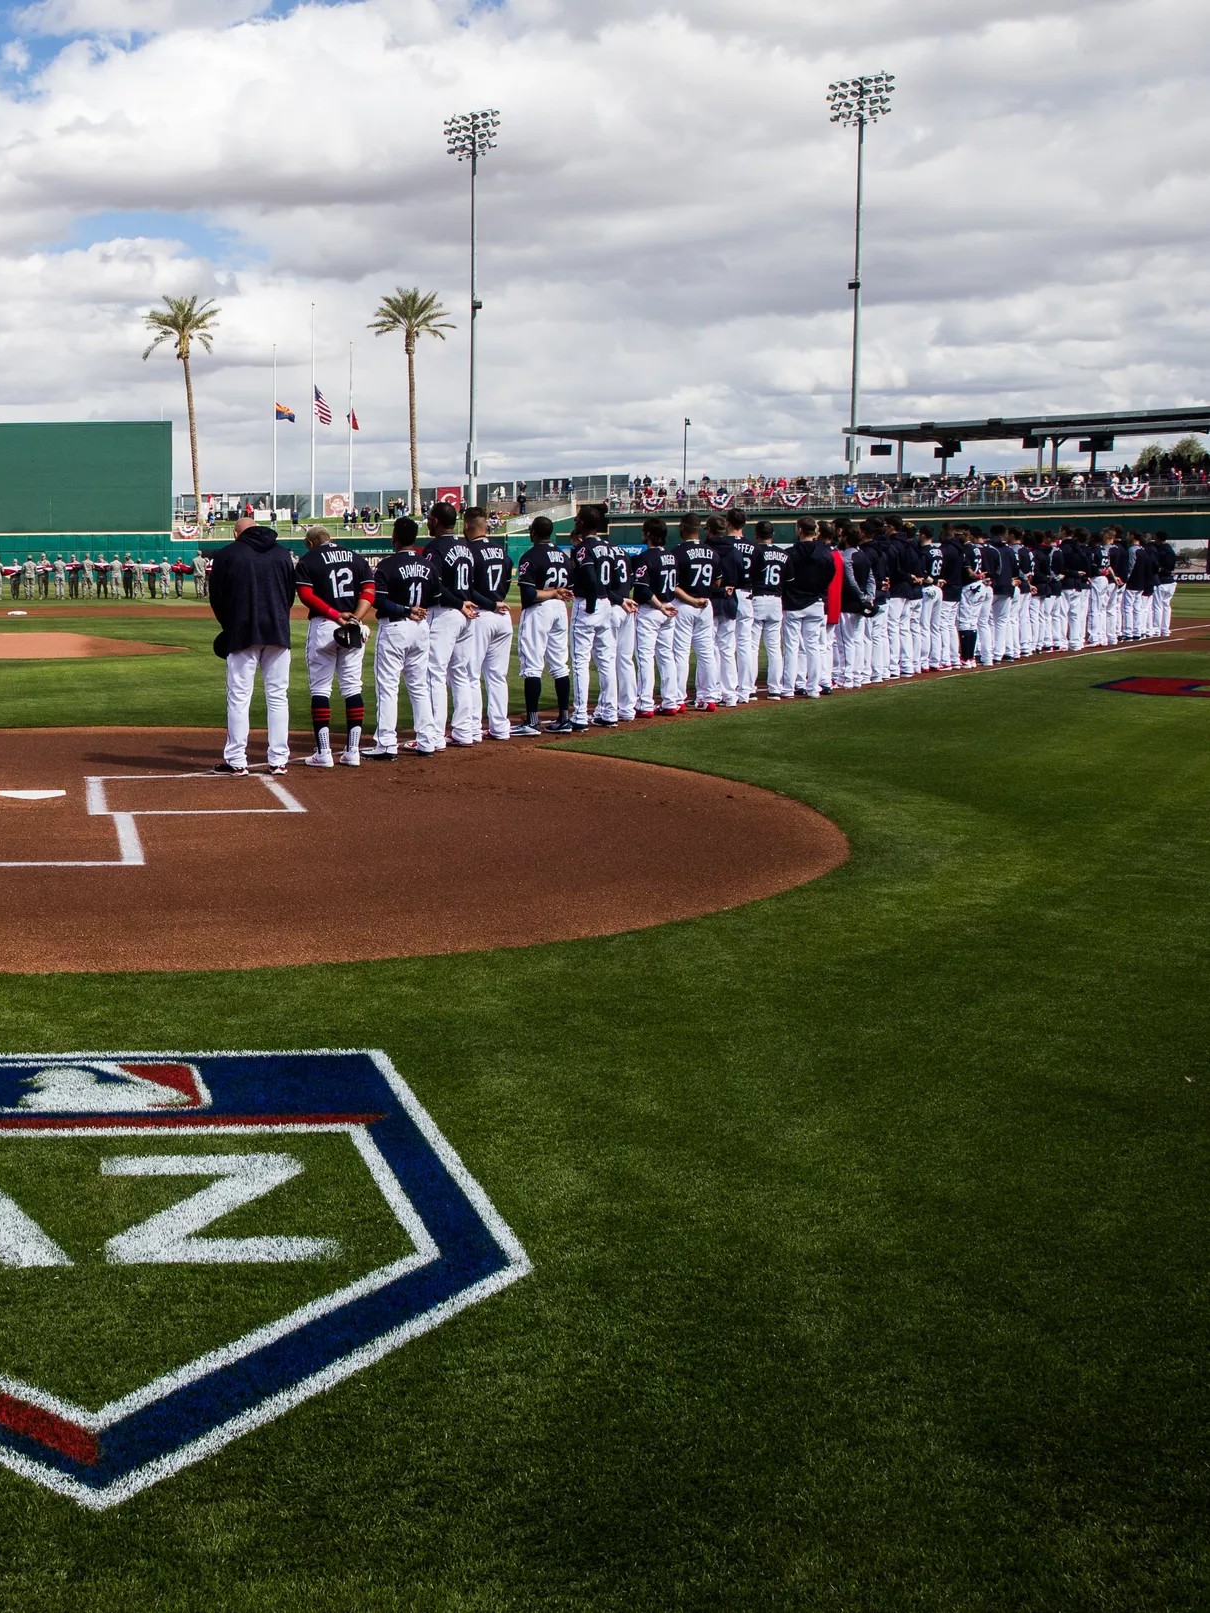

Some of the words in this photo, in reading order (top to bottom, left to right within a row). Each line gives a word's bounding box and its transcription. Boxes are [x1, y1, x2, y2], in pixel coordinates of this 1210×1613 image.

[320, 550, 354, 565] LINDOR
[480, 547, 504, 562] ALONSO
[686, 548, 714, 561] BRADLEY
[329, 567, 355, 600] 12
[456, 563, 469, 591] 10
[486, 564, 503, 592] 17
[544, 567, 569, 590] 26
[660, 569, 677, 594] 70
[690, 564, 713, 587] 79
[764, 565, 781, 587] 16
[408, 582, 422, 606] 11
